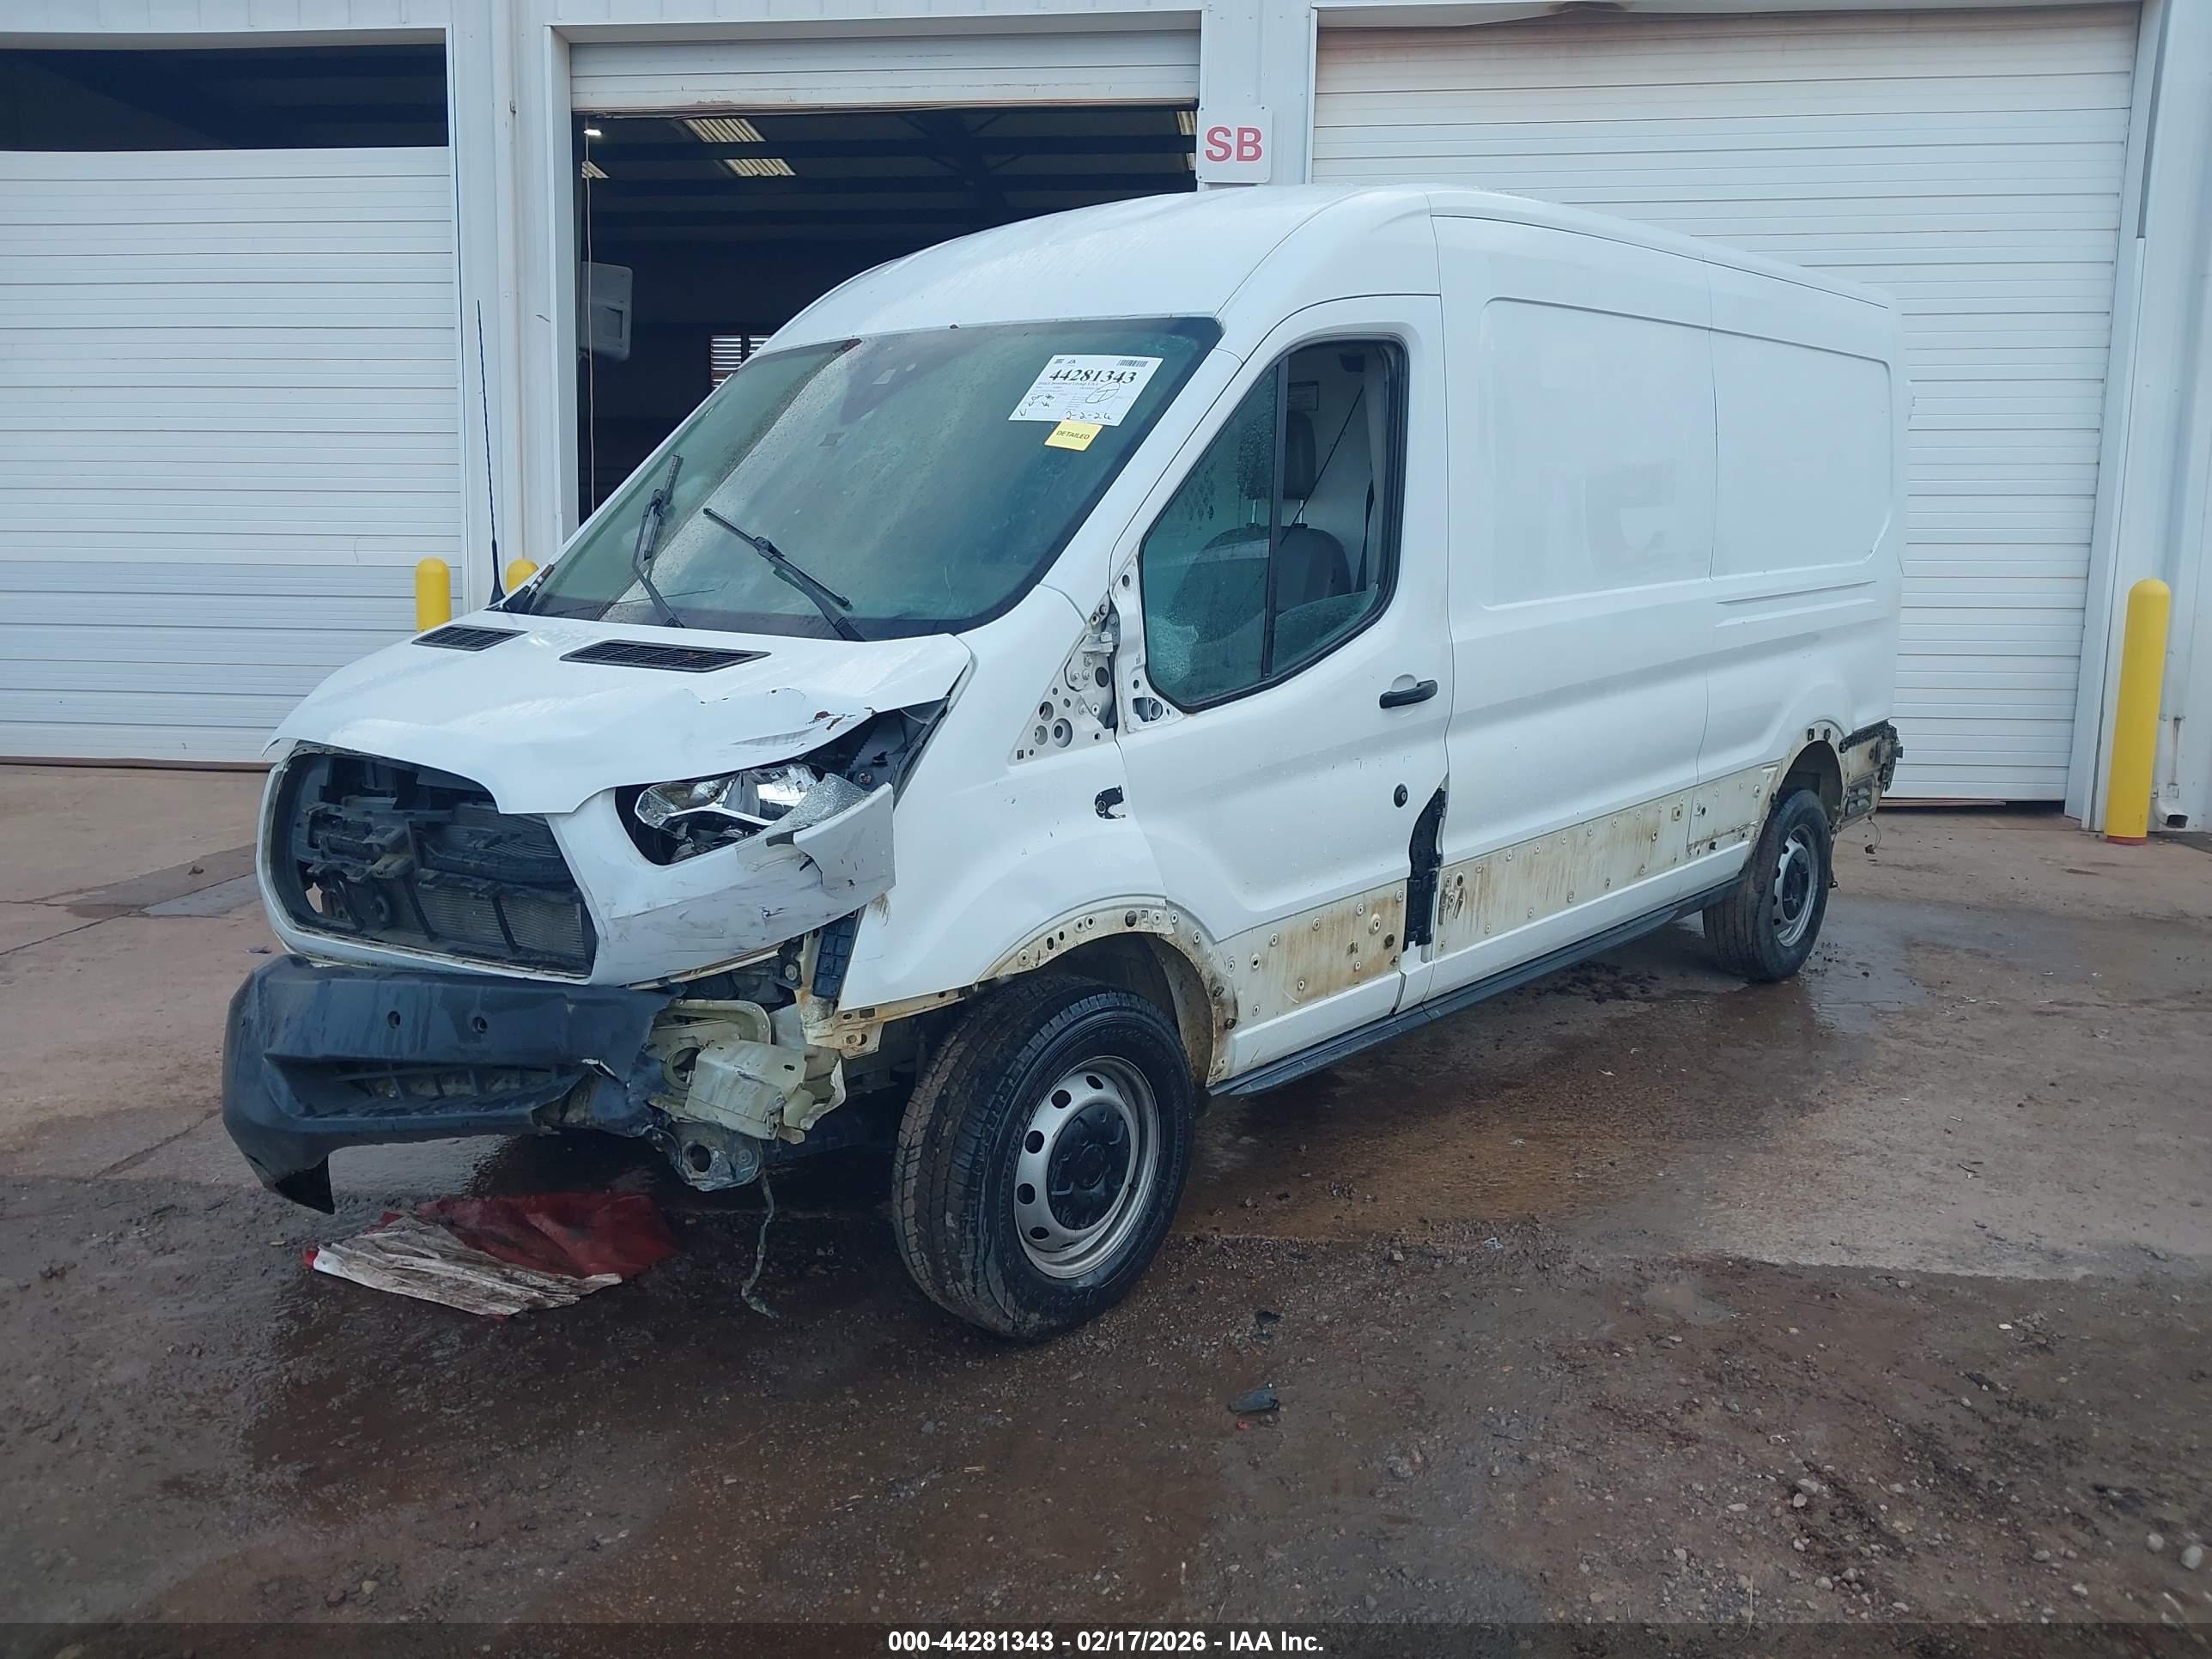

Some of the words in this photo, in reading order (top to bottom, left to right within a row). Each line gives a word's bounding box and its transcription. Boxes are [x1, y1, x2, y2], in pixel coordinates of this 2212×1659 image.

[1205, 126, 1263, 162] SB
[1048, 369, 1138, 385] 44281343
[1056, 430, 1091, 440] DETAILED
